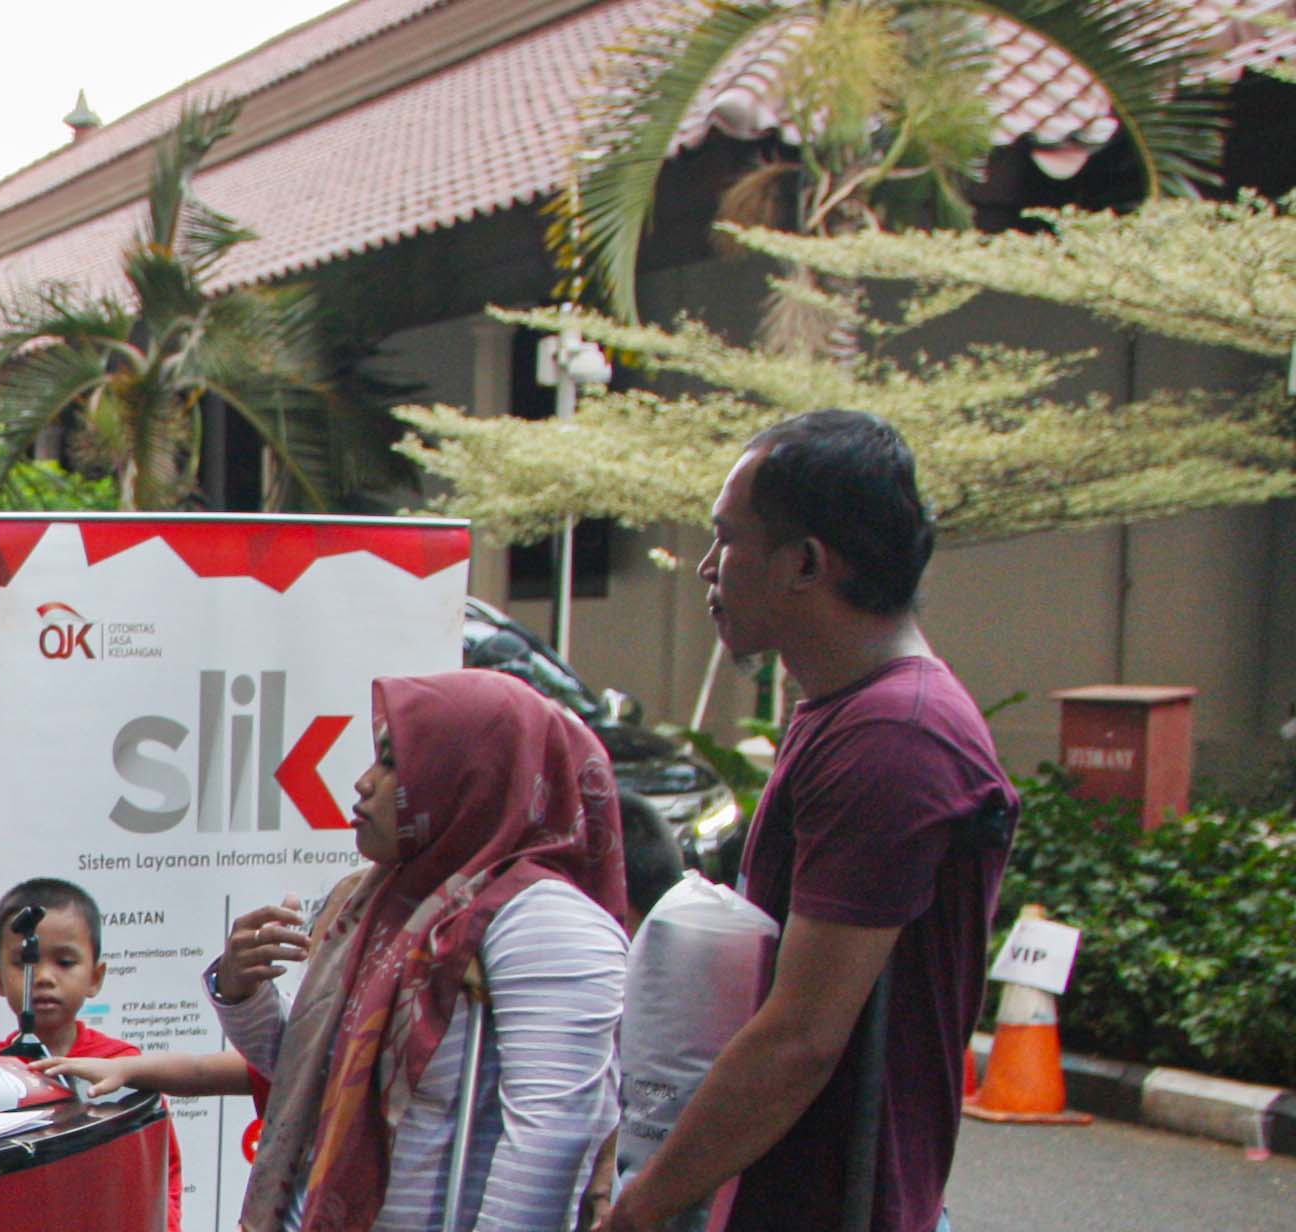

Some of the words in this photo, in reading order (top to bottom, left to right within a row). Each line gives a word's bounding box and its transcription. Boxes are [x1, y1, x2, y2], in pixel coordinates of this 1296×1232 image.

[108, 623, 155, 634] OTORITAS
[39, 623, 96, 659] OJK
[108, 635, 132, 646] JASA
[108, 647, 162, 658] KEUANGAN
[109, 669, 355, 834] slik
[78, 854, 130, 870] Sistem
[136, 853, 210, 872] Layanan
[216, 850, 288, 867] Informasi
[293, 849, 368, 867] Keuang
[101, 911, 165, 926] YARATAN
[102, 950, 122, 959] men
[1010, 946, 1048, 965] VIP
[158, 1000, 178, 1010] atau
